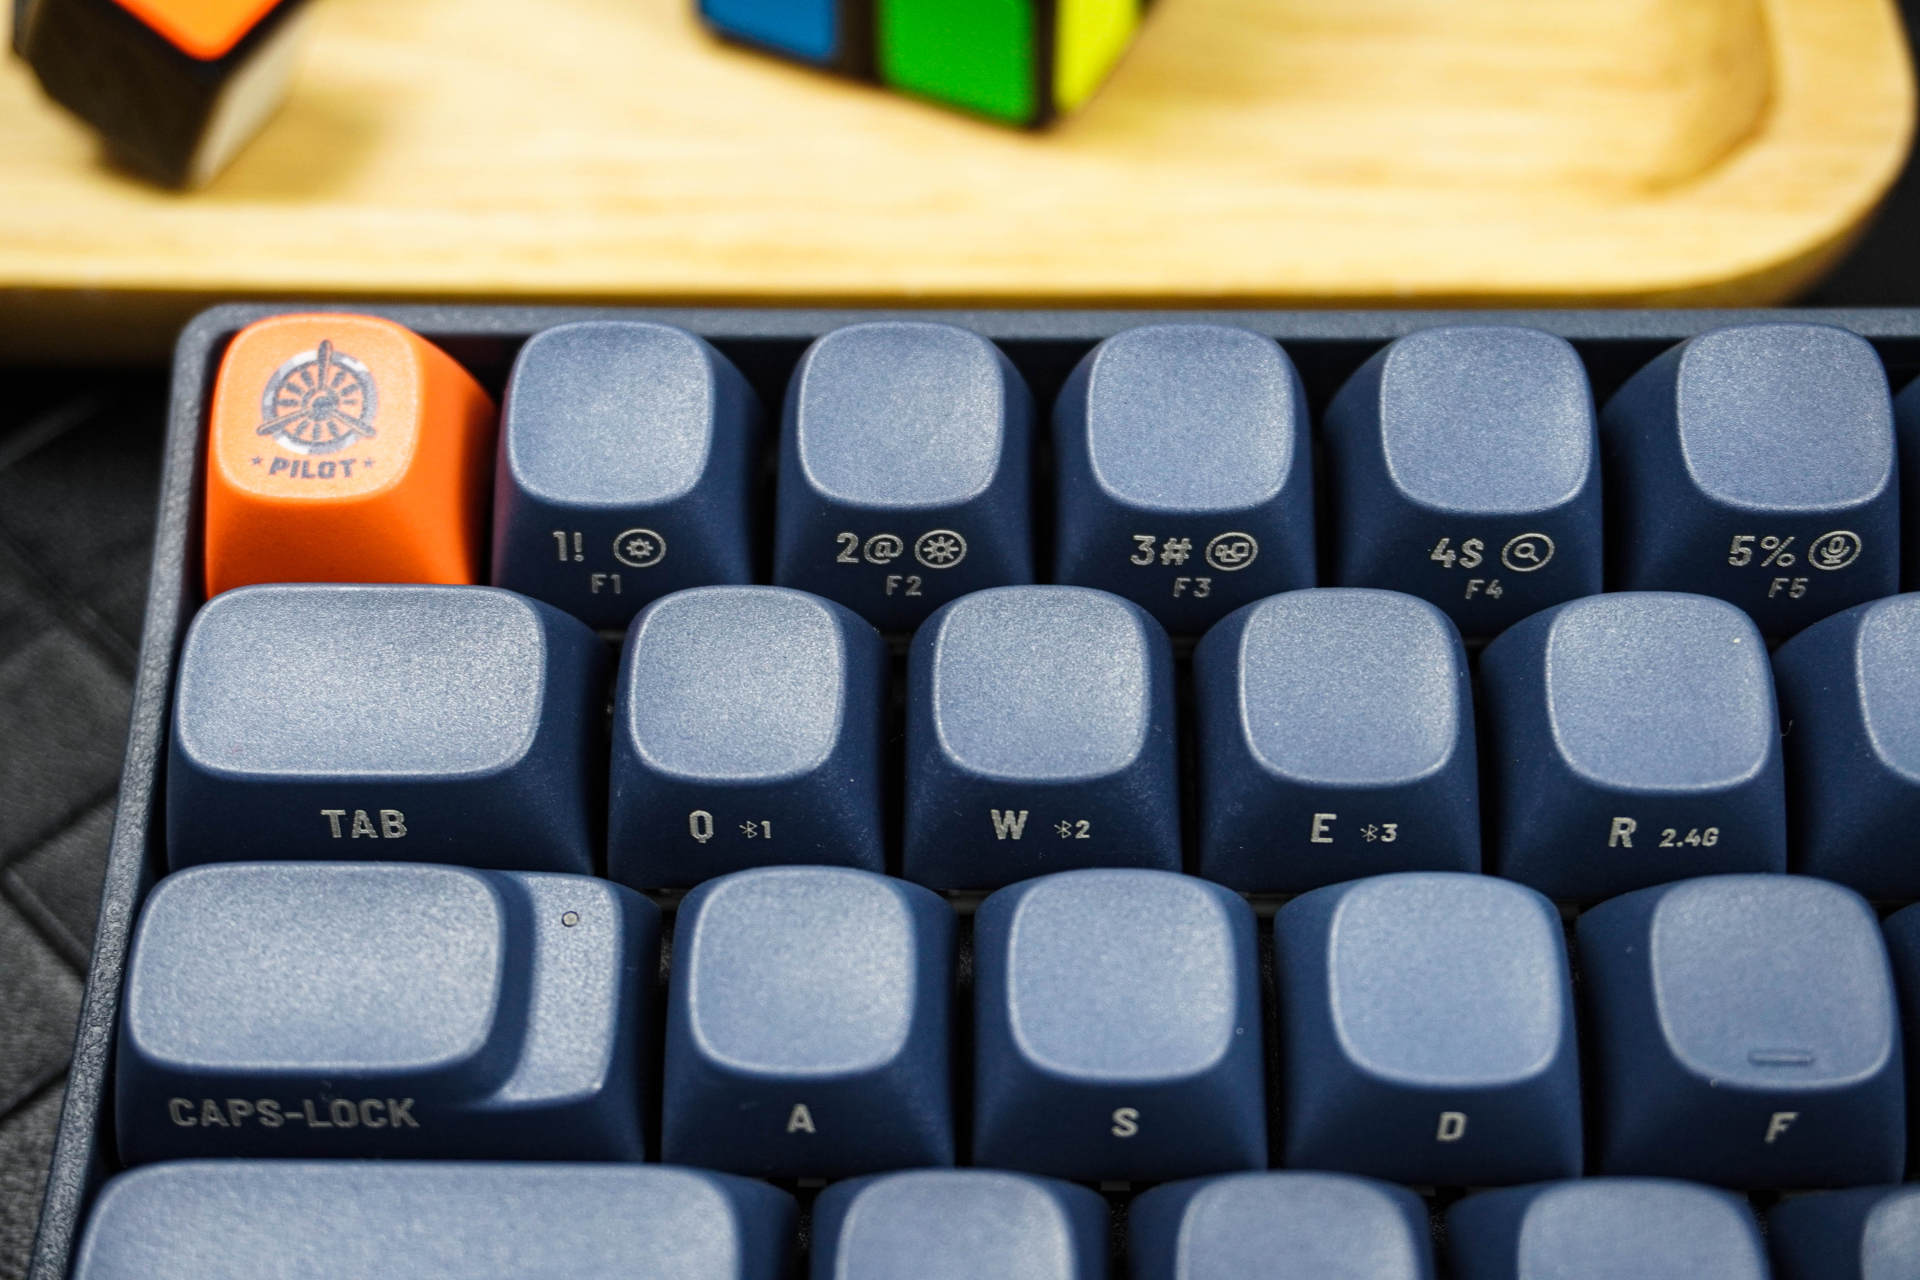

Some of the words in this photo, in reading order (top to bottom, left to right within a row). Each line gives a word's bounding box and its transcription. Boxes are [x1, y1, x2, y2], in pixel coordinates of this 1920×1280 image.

[269, 457, 357, 479] PILOT
[591, 573, 622, 594] F1
[886, 575, 923, 596] F2
[1173, 577, 1213, 598] F3
[1464, 579, 1504, 600] F4
[1767, 577, 1809, 599] F5
[320, 809, 408, 839] TAB
[689, 809, 715, 844] Q
[990, 809, 1029, 840] W
[1310, 813, 1338, 844] E
[1608, 816, 1637, 848] R
[1658, 827, 1720, 848] 2.4G
[168, 1097, 421, 1129] CAPS-LOCK
[787, 1103, 816, 1133] A
[1111, 1107, 1140, 1138] S
[1436, 1111, 1467, 1142] D
[1765, 1112, 1799, 1143] F
